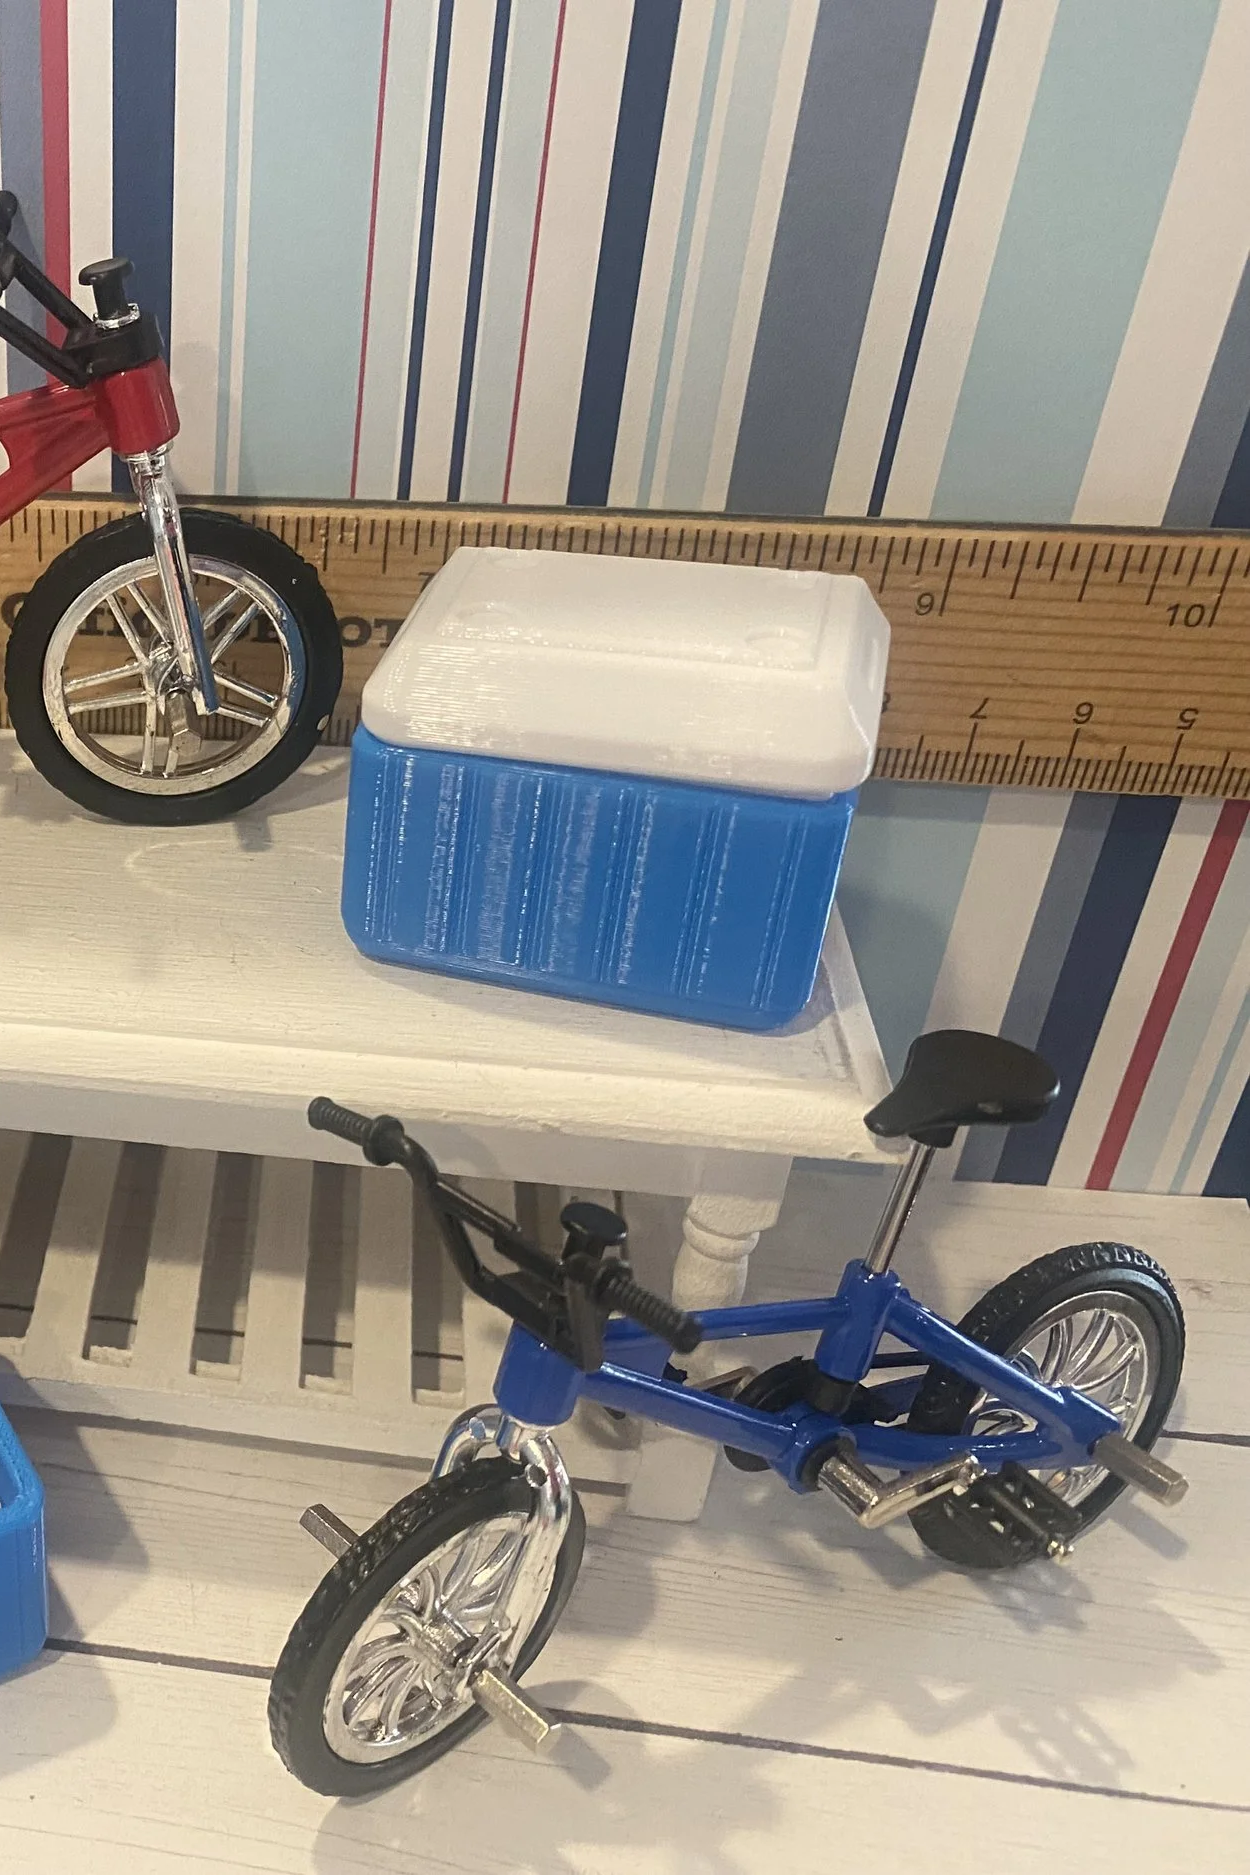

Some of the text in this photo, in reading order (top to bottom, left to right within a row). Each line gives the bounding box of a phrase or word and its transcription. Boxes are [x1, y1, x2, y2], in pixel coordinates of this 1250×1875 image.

[914, 592, 936, 616] 9
[1165, 603, 1206, 628] 10
[969, 697, 990, 720] 7
[1072, 702, 1095, 725] 6
[1176, 707, 1200, 731] 5
